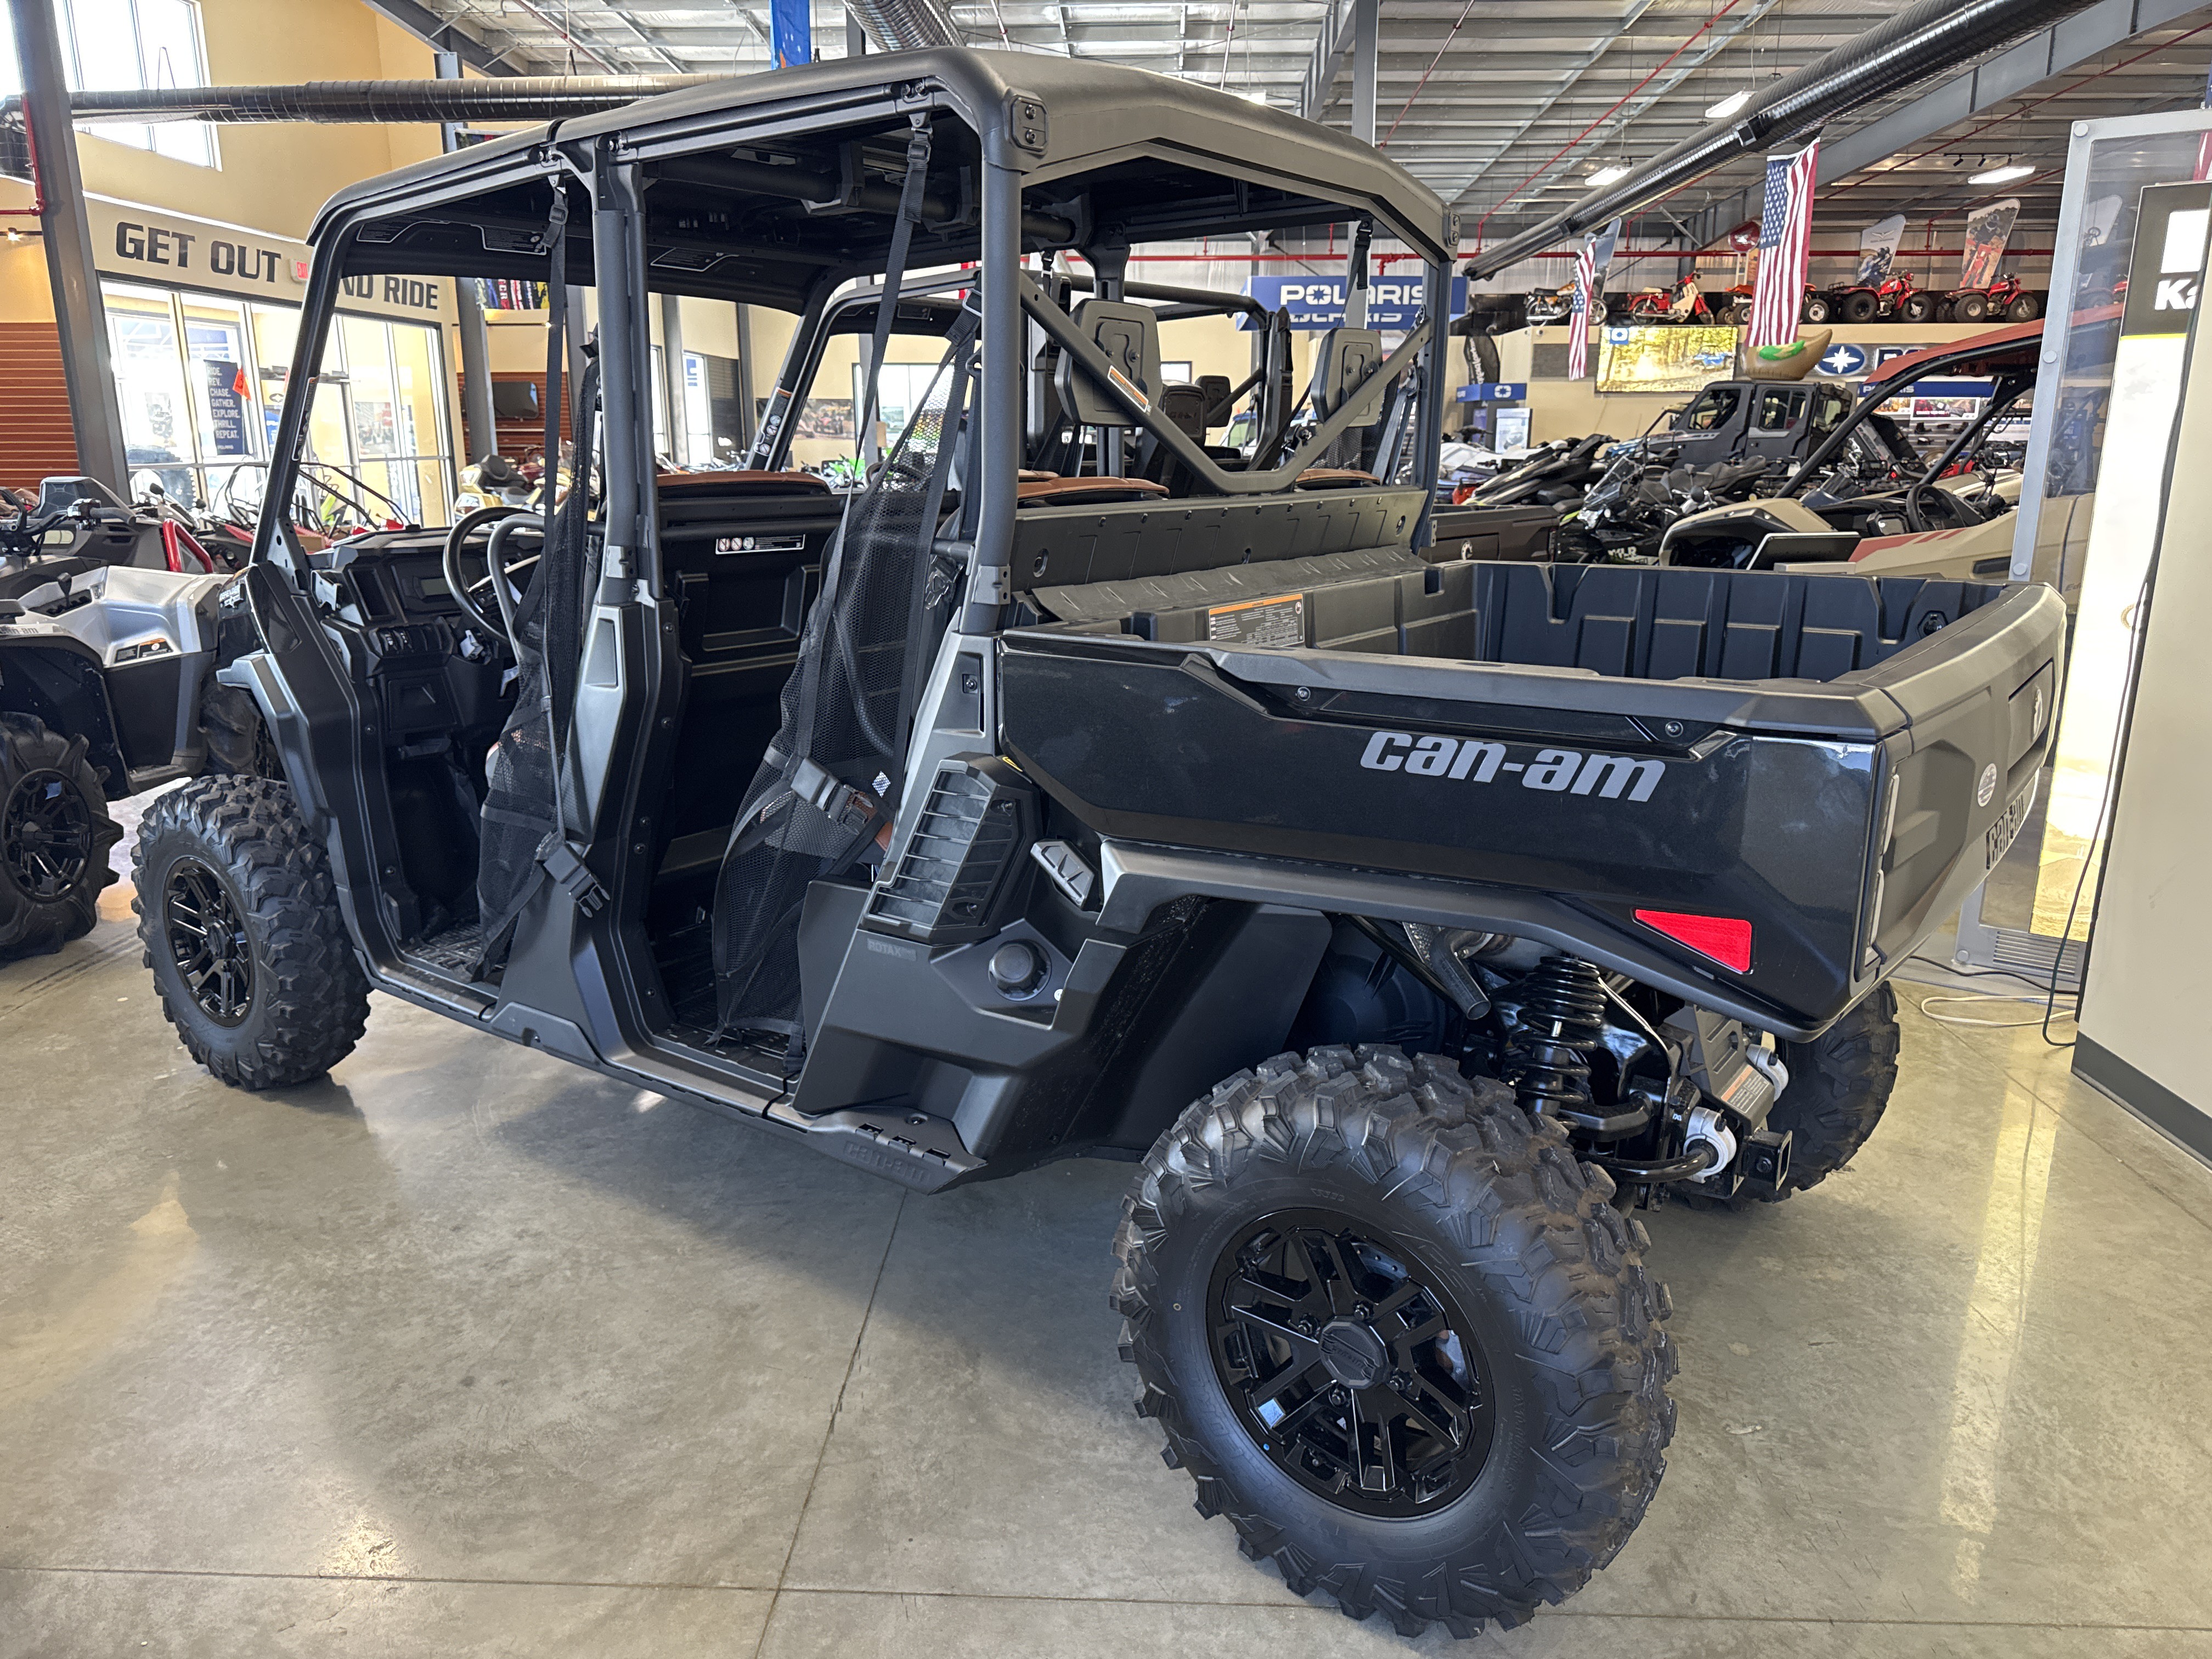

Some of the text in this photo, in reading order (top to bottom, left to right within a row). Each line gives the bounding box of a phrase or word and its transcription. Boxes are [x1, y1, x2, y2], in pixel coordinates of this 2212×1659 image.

[116, 221, 196, 268] GET
[211, 240, 281, 283] OUT
[337, 275, 374, 300] ND
[384, 275, 438, 311] RIDE
[1280, 285, 1423, 306] POLRIS
[210, 388, 231, 397] CHASE.
[211, 399, 236, 408] GATHER.
[212, 409, 240, 419] EXPLORE.
[213, 420, 236, 428] THRILL.
[215, 431, 239, 439] REPEAT.
[1360, 731, 1666, 803] can-am
